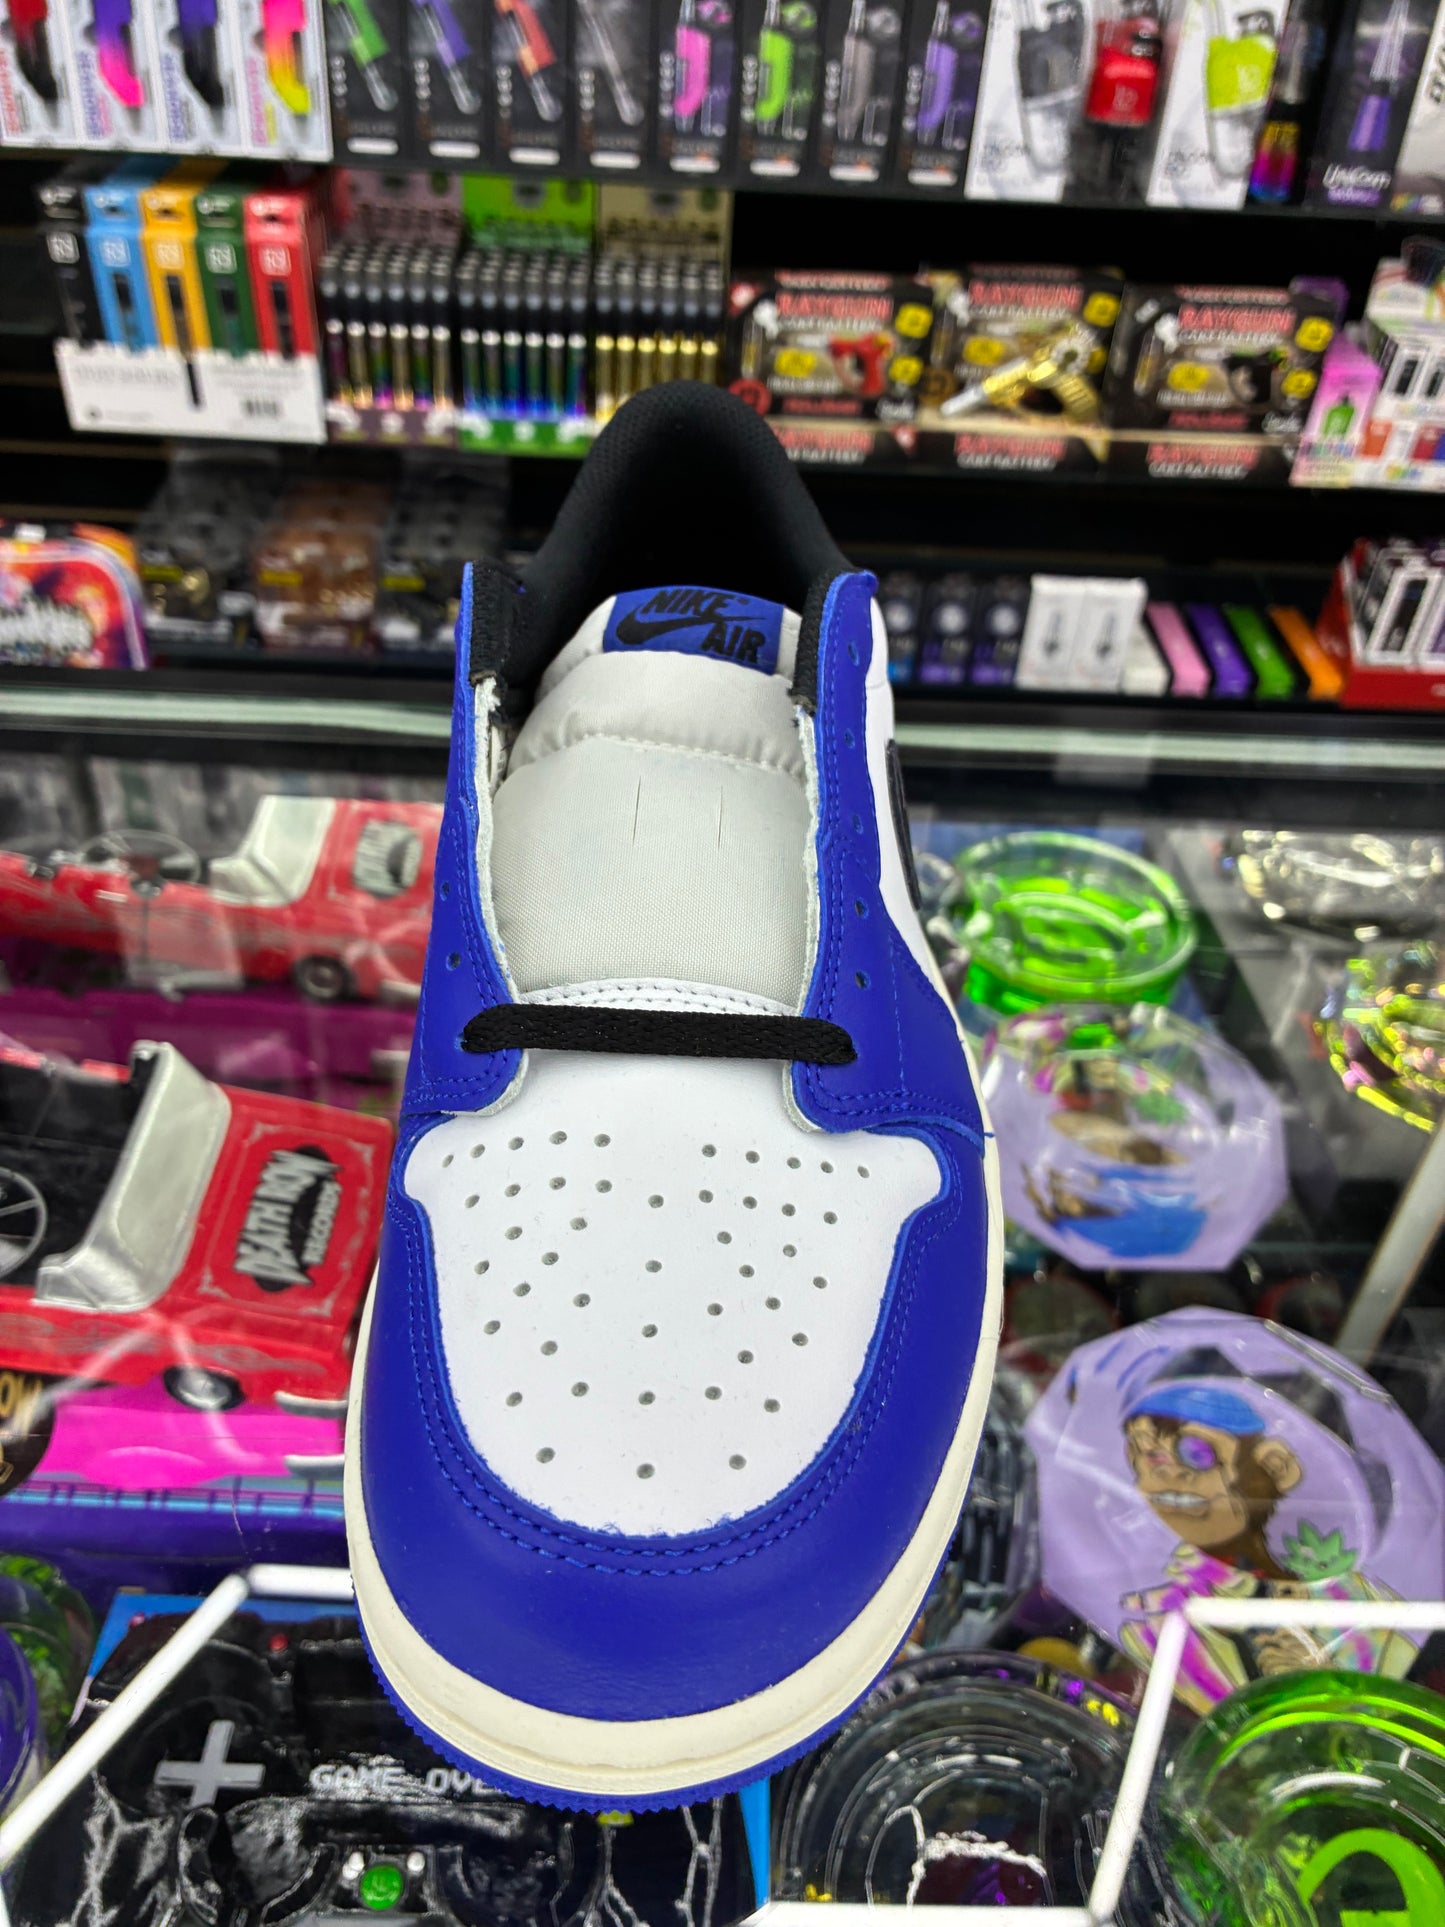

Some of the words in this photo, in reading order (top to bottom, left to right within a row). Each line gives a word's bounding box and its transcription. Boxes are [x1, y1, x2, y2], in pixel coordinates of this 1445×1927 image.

[641, 589, 734, 618] NIKE
[701, 622, 767, 664] AIR
[254, 1150, 343, 1203] ROW
[233, 1199, 314, 1286] DEATH
[0, 1371, 42, 1441] OW
[309, 1764, 407, 1792] GAME
[426, 1768, 497, 1796] OVE
